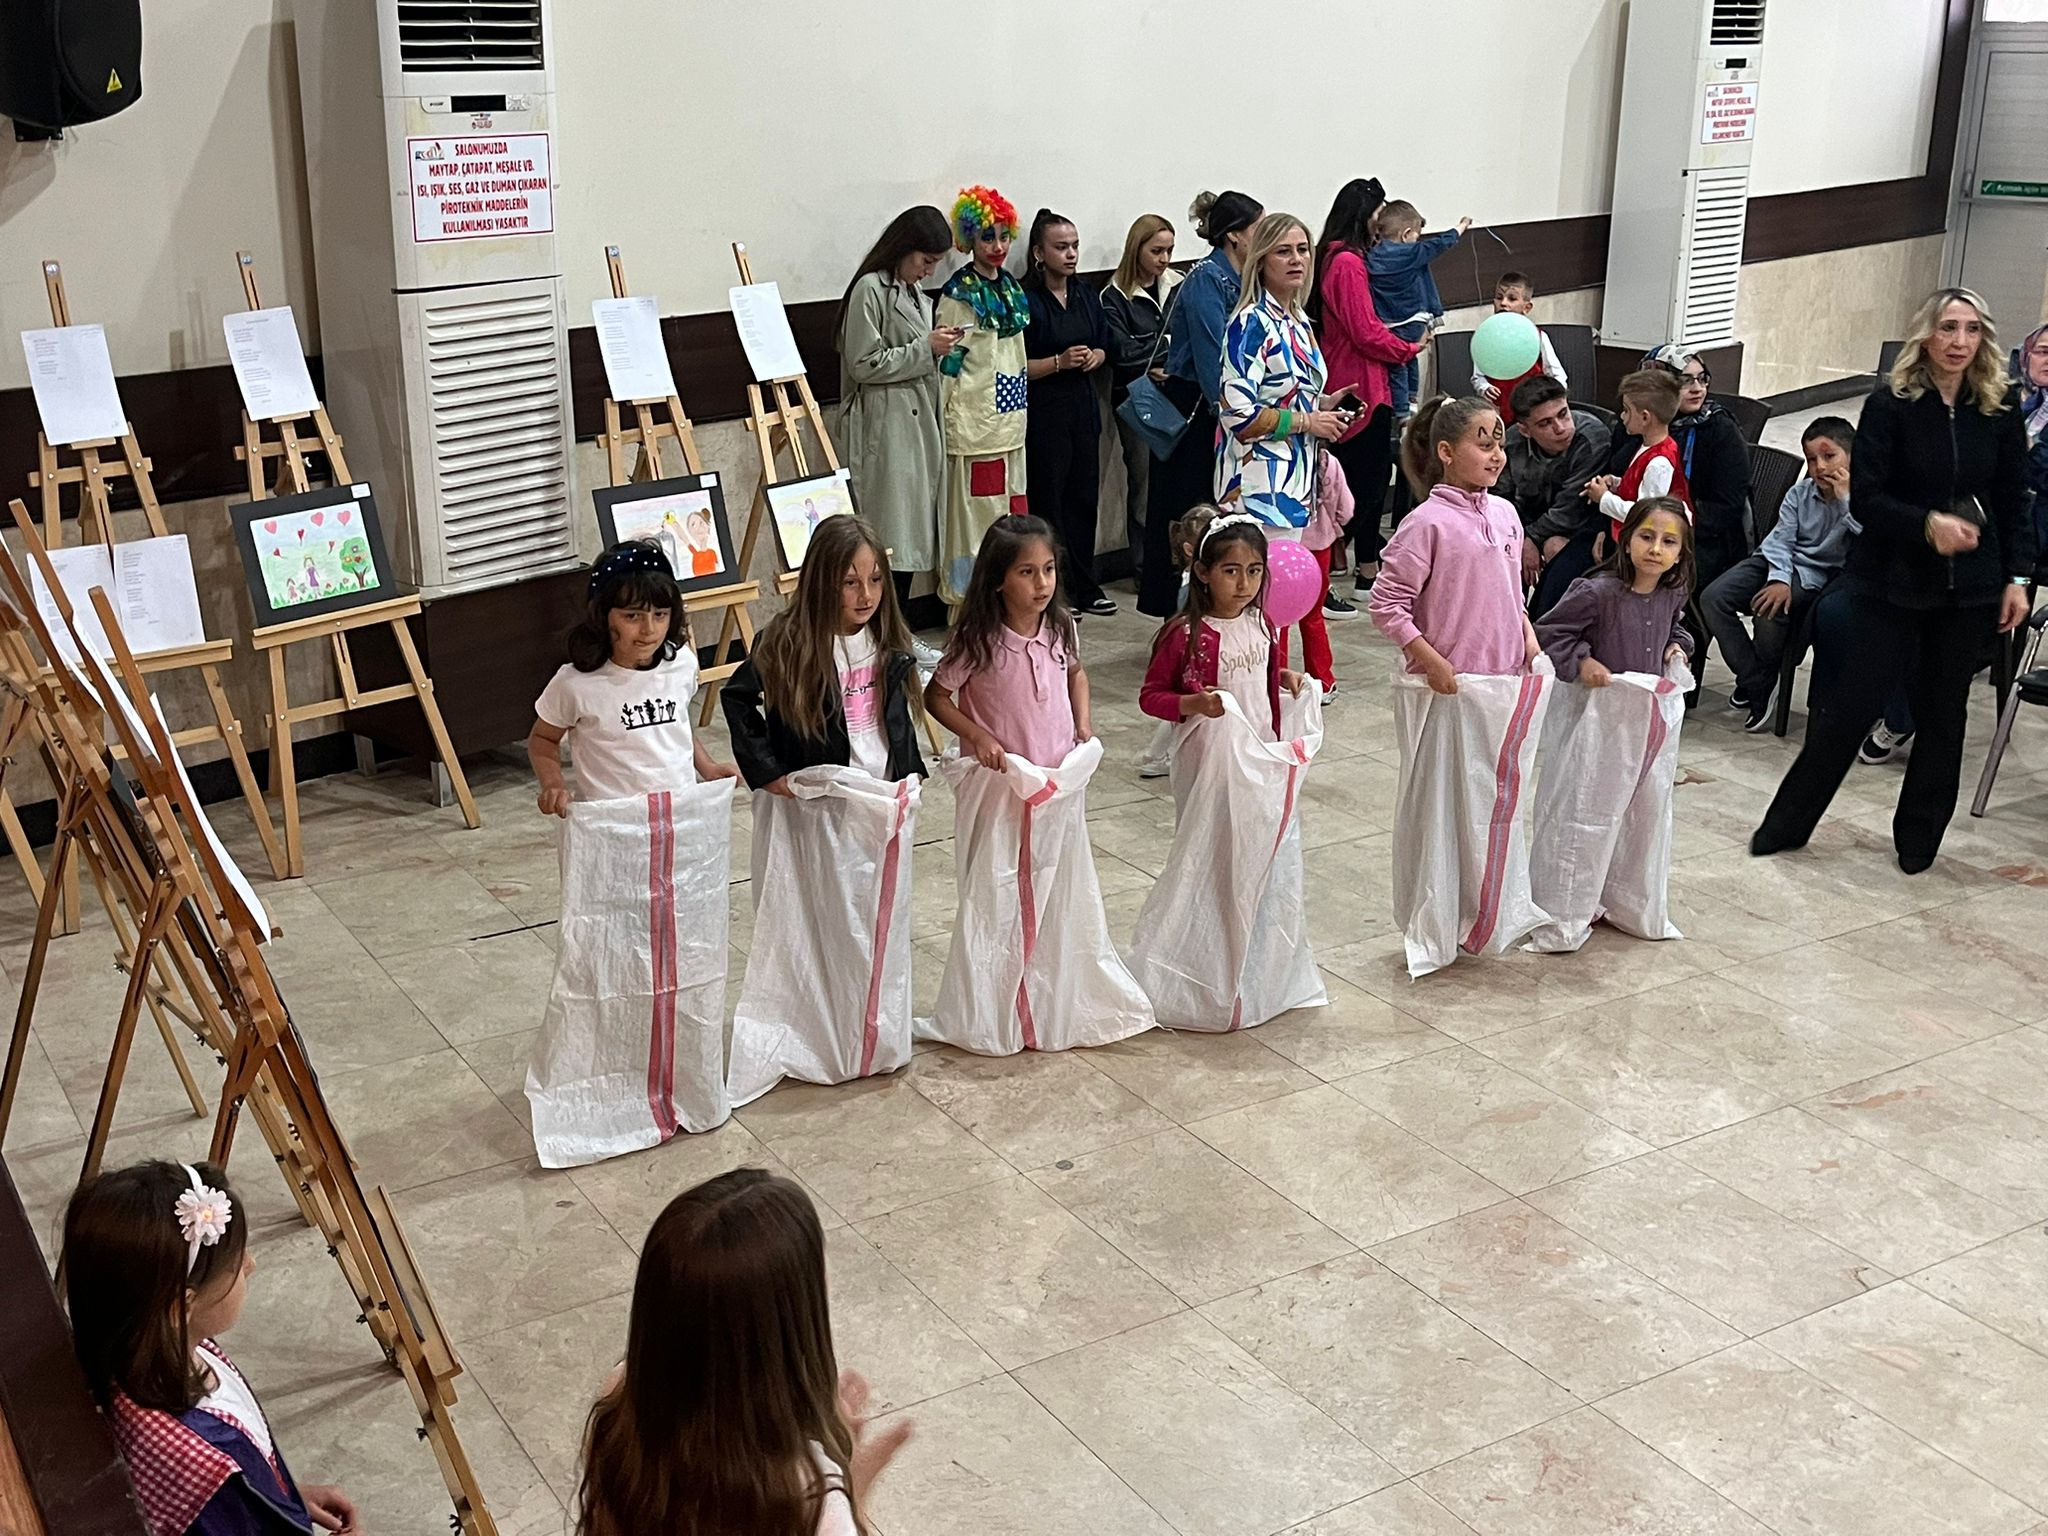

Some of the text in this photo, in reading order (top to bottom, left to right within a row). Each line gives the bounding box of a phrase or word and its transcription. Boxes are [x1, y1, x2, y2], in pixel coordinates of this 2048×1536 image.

[455, 142, 508, 156] SALONUMUZDA
[429, 163, 460, 177] MAYTAP,
[462, 161, 495, 177] ÇATAPAT,
[496, 160, 522, 175] MEŞALE
[449, 182, 464, 196] SES,
[465, 181, 479, 194] GAZ
[481, 180, 490, 193] VE
[491, 179, 517, 193] DUMAN
[518, 177, 547, 193] ÇIKARAN
[441, 195, 528, 215] PİROTEKNİK MADDELERİN
[443, 216, 529, 234] KULLANILMASI YASAKTIR
